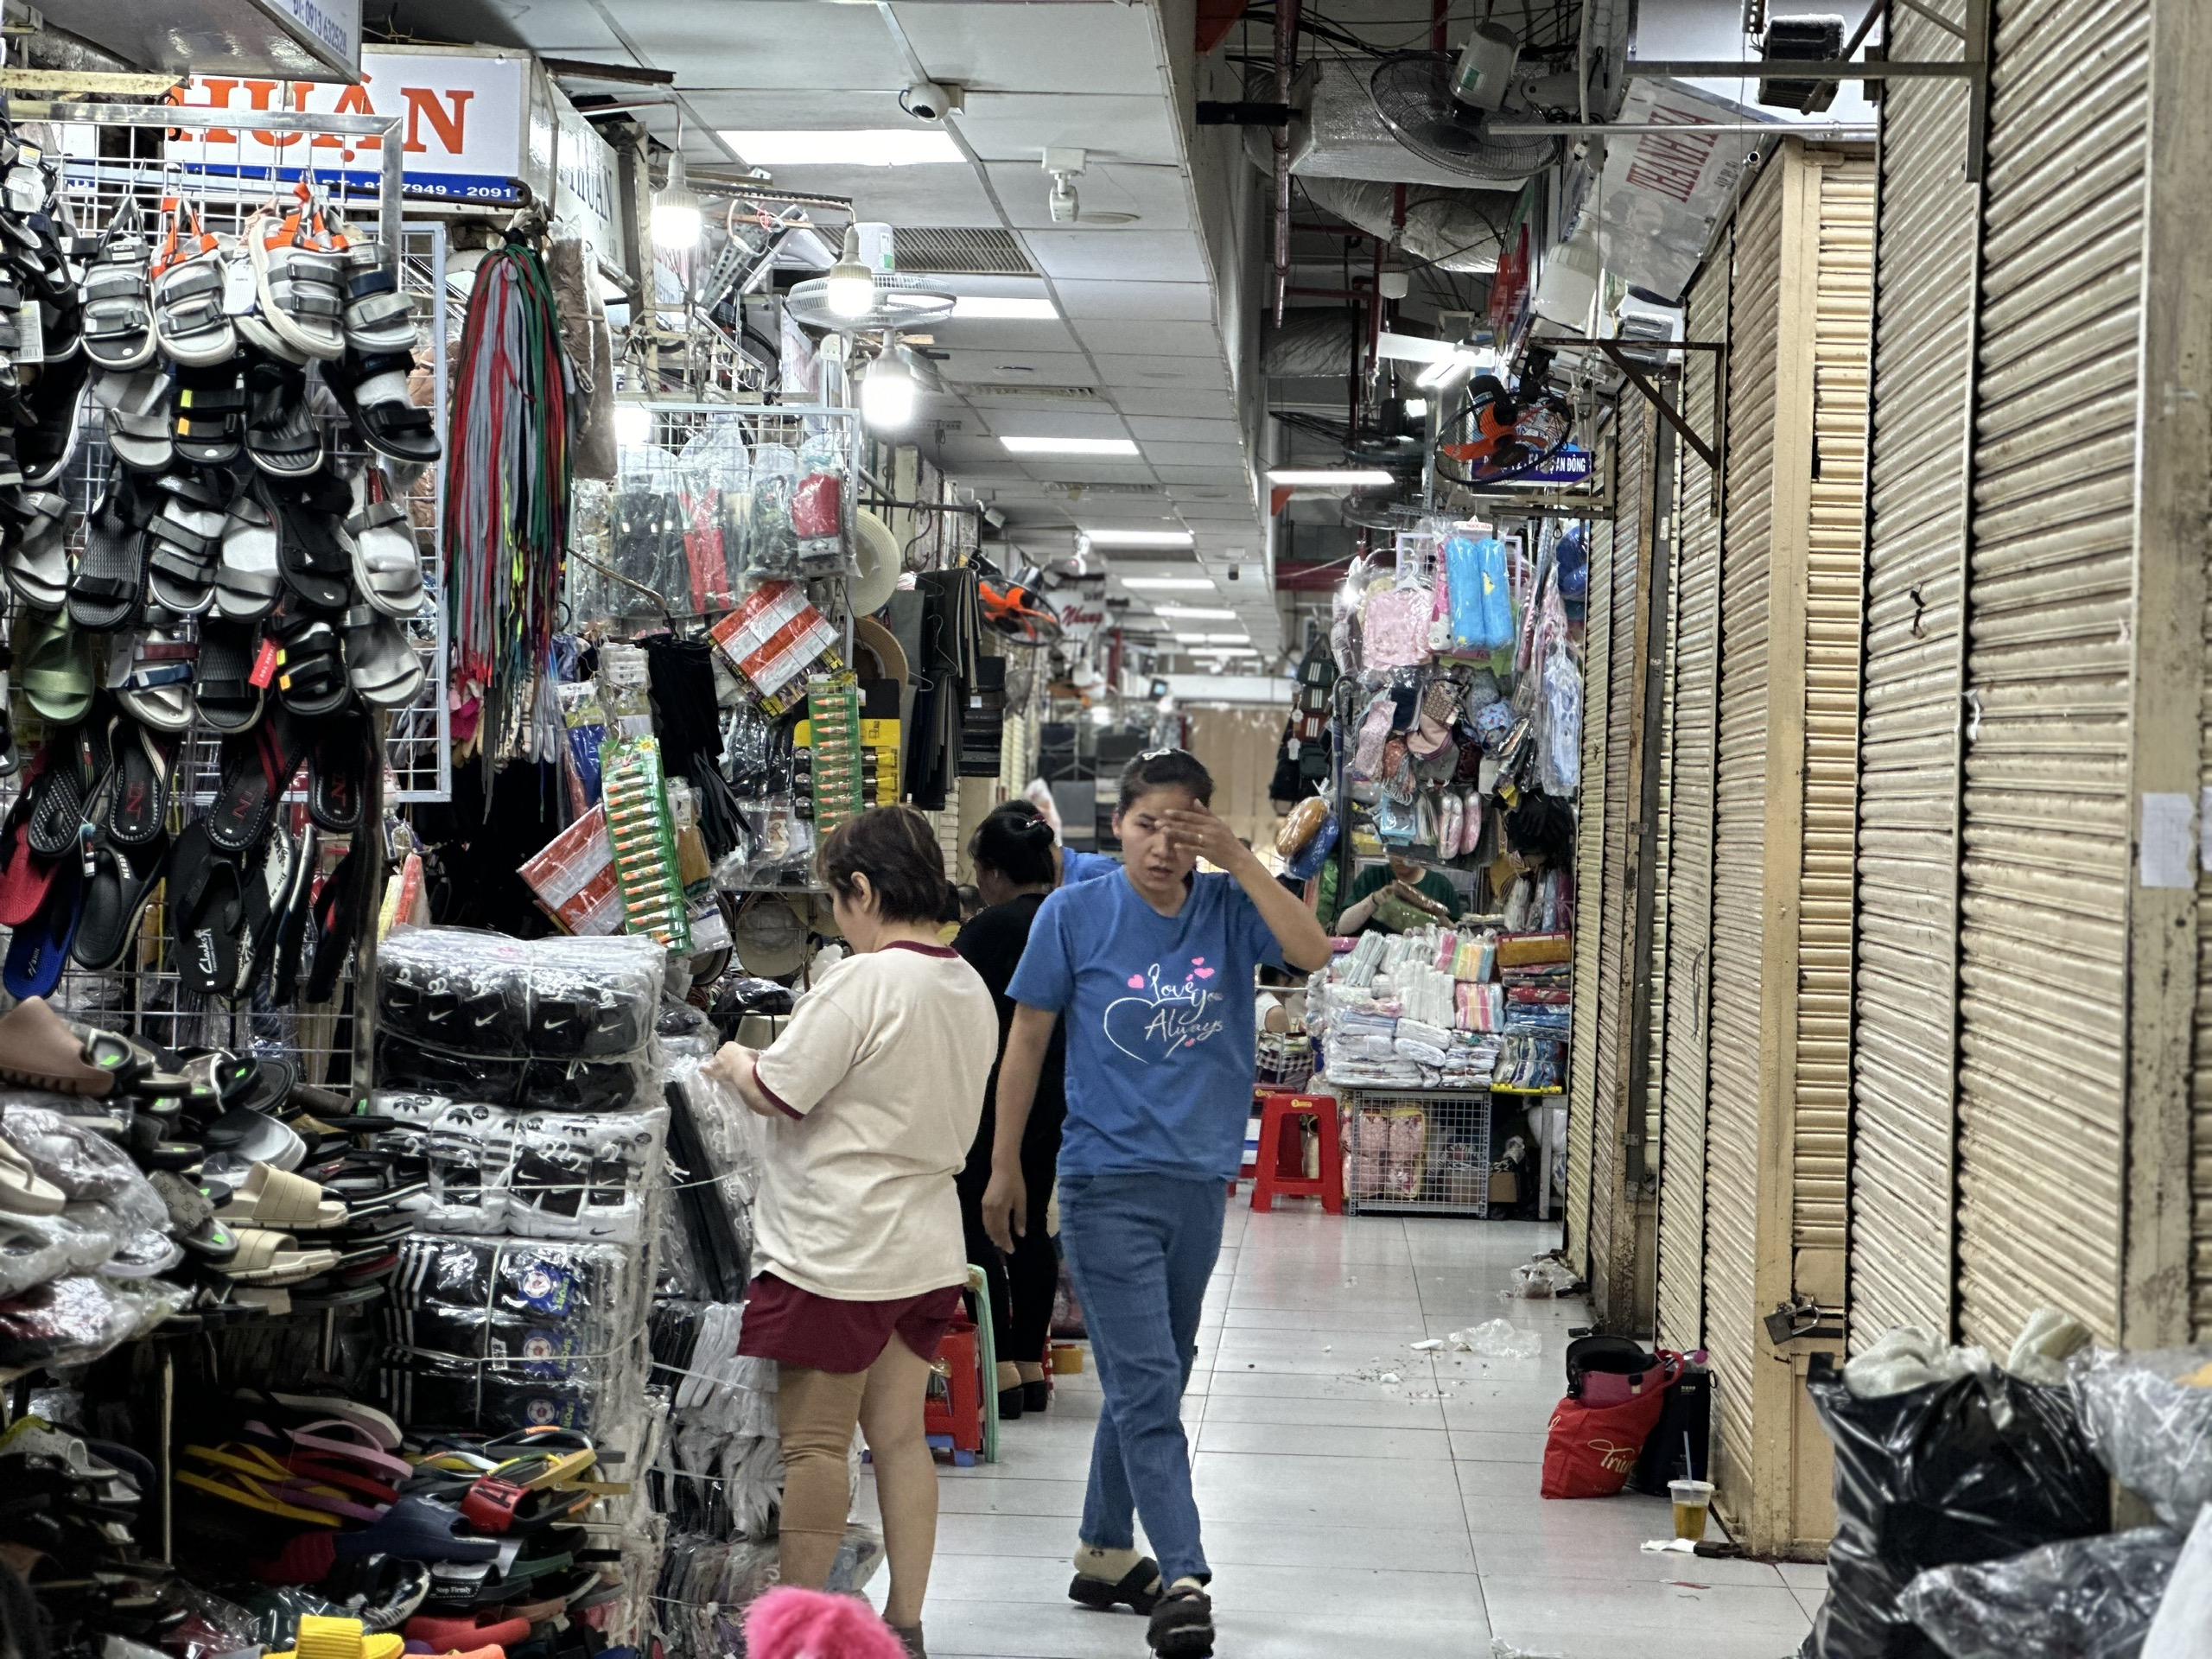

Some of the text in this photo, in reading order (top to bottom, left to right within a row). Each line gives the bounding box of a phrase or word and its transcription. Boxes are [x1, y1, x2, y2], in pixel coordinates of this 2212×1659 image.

[1625, 131, 1710, 204] THANH
[467, 186, 512, 198] 2091
[1567, 454, 1586, 473] ĐÔNG
[117, 853, 130, 880] NERDY
[198, 936, 213, 974] Clarks
[1147, 963, 1199, 1001] Love
[1144, 1008, 1224, 1042] Always
[557, 1277, 570, 1310] SPORT
